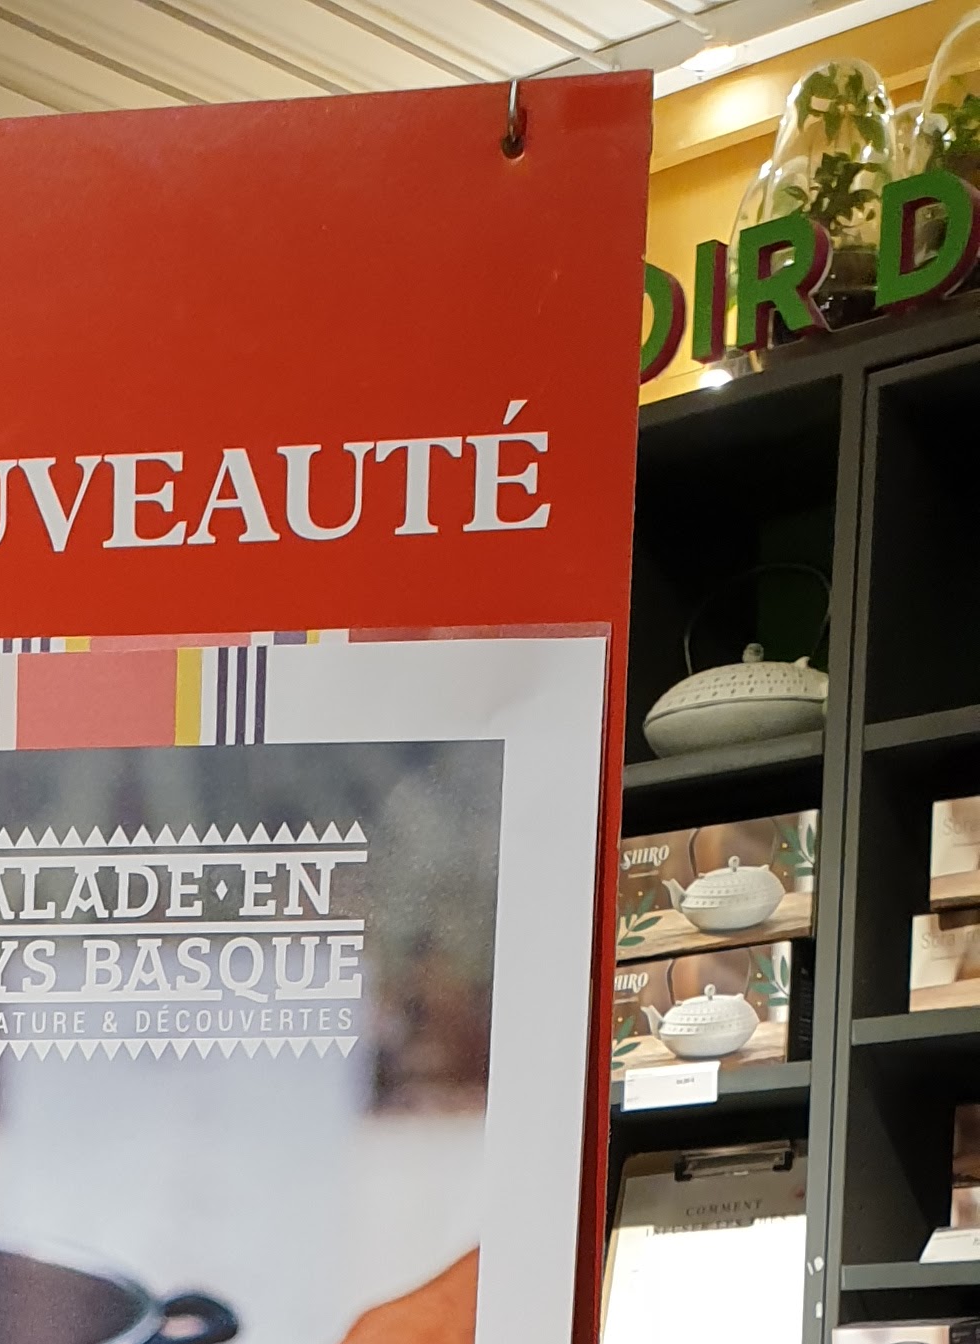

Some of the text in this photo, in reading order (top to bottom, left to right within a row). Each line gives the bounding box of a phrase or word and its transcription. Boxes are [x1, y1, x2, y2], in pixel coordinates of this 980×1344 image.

[621, 844, 670, 870] SHIRO
[239, 858, 336, 916] EN
[81, 936, 364, 1002] BASQUE
[103, 1011, 118, 1033] &
[136, 1004, 353, 1033] DÉCOUVERTES
[685, 1198, 764, 1217] COMMENT
